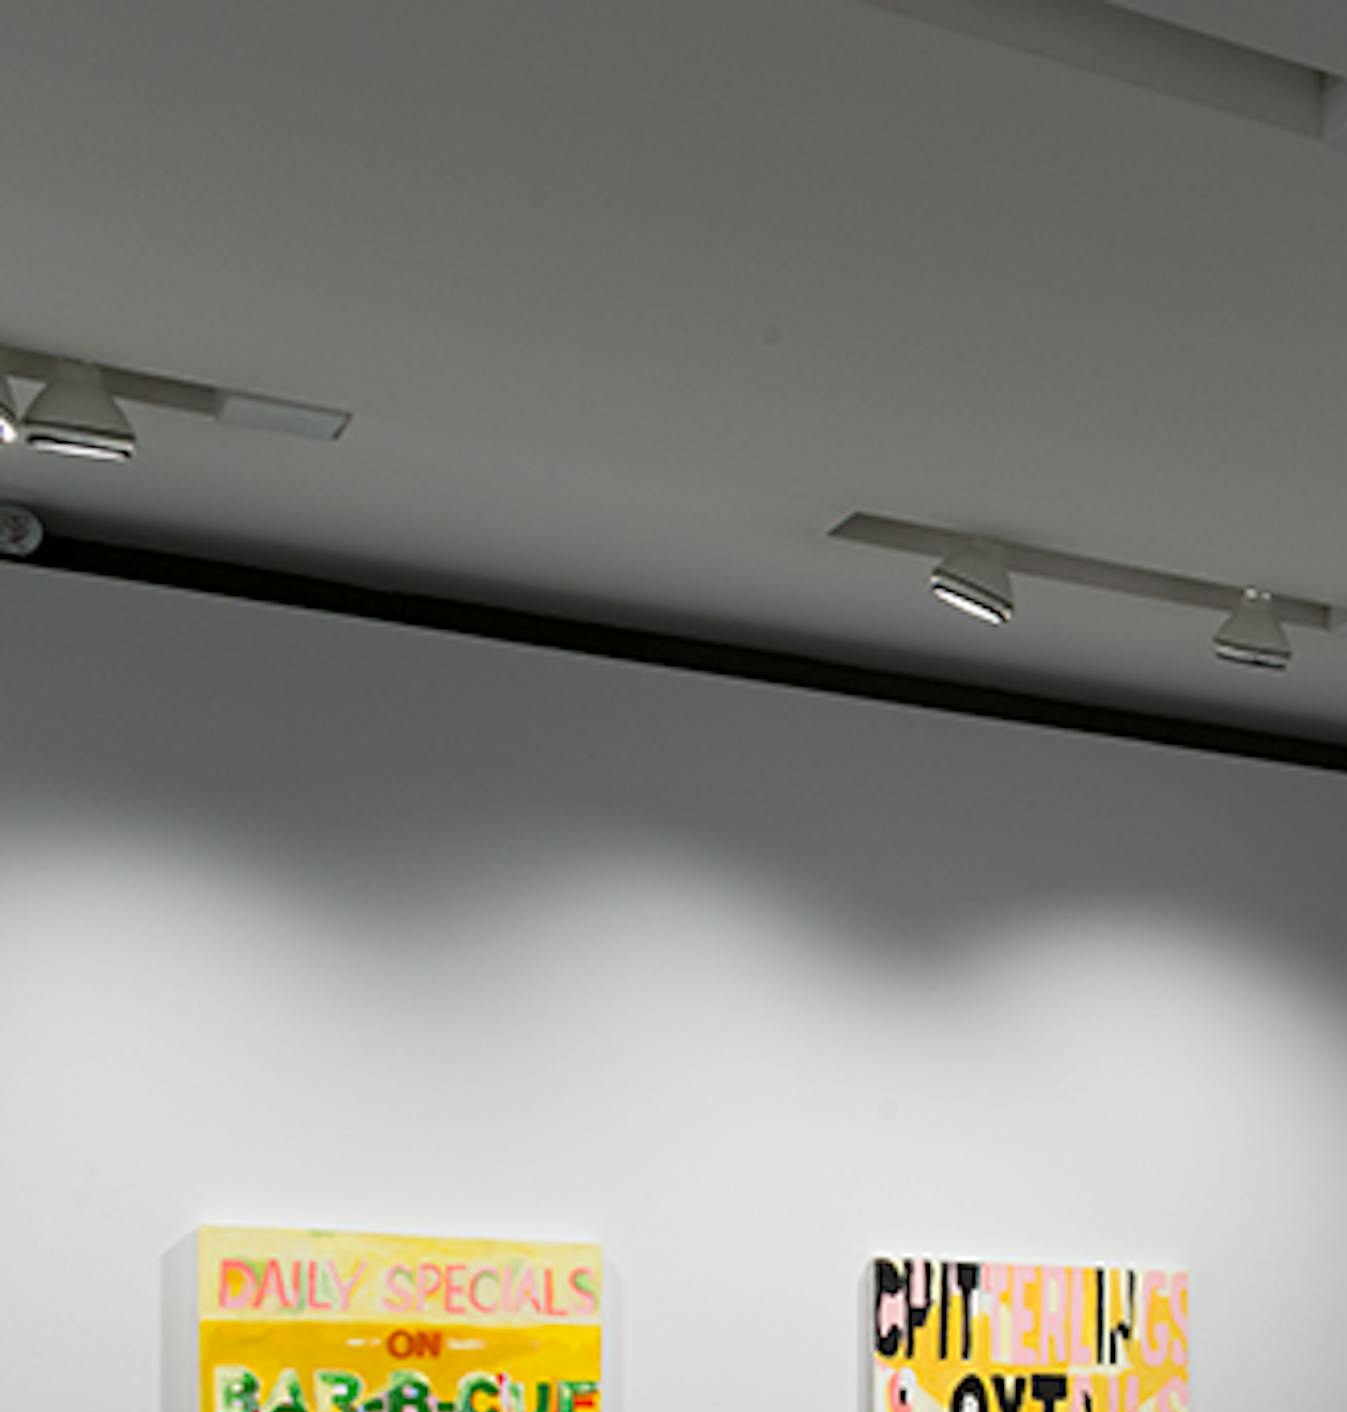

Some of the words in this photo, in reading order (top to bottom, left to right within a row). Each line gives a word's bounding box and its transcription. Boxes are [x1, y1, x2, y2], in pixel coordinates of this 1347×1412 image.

[217, 1258, 366, 1312] DAILY
[382, 1262, 599, 1316] SPECIALS
[386, 1330, 443, 1359] ON
